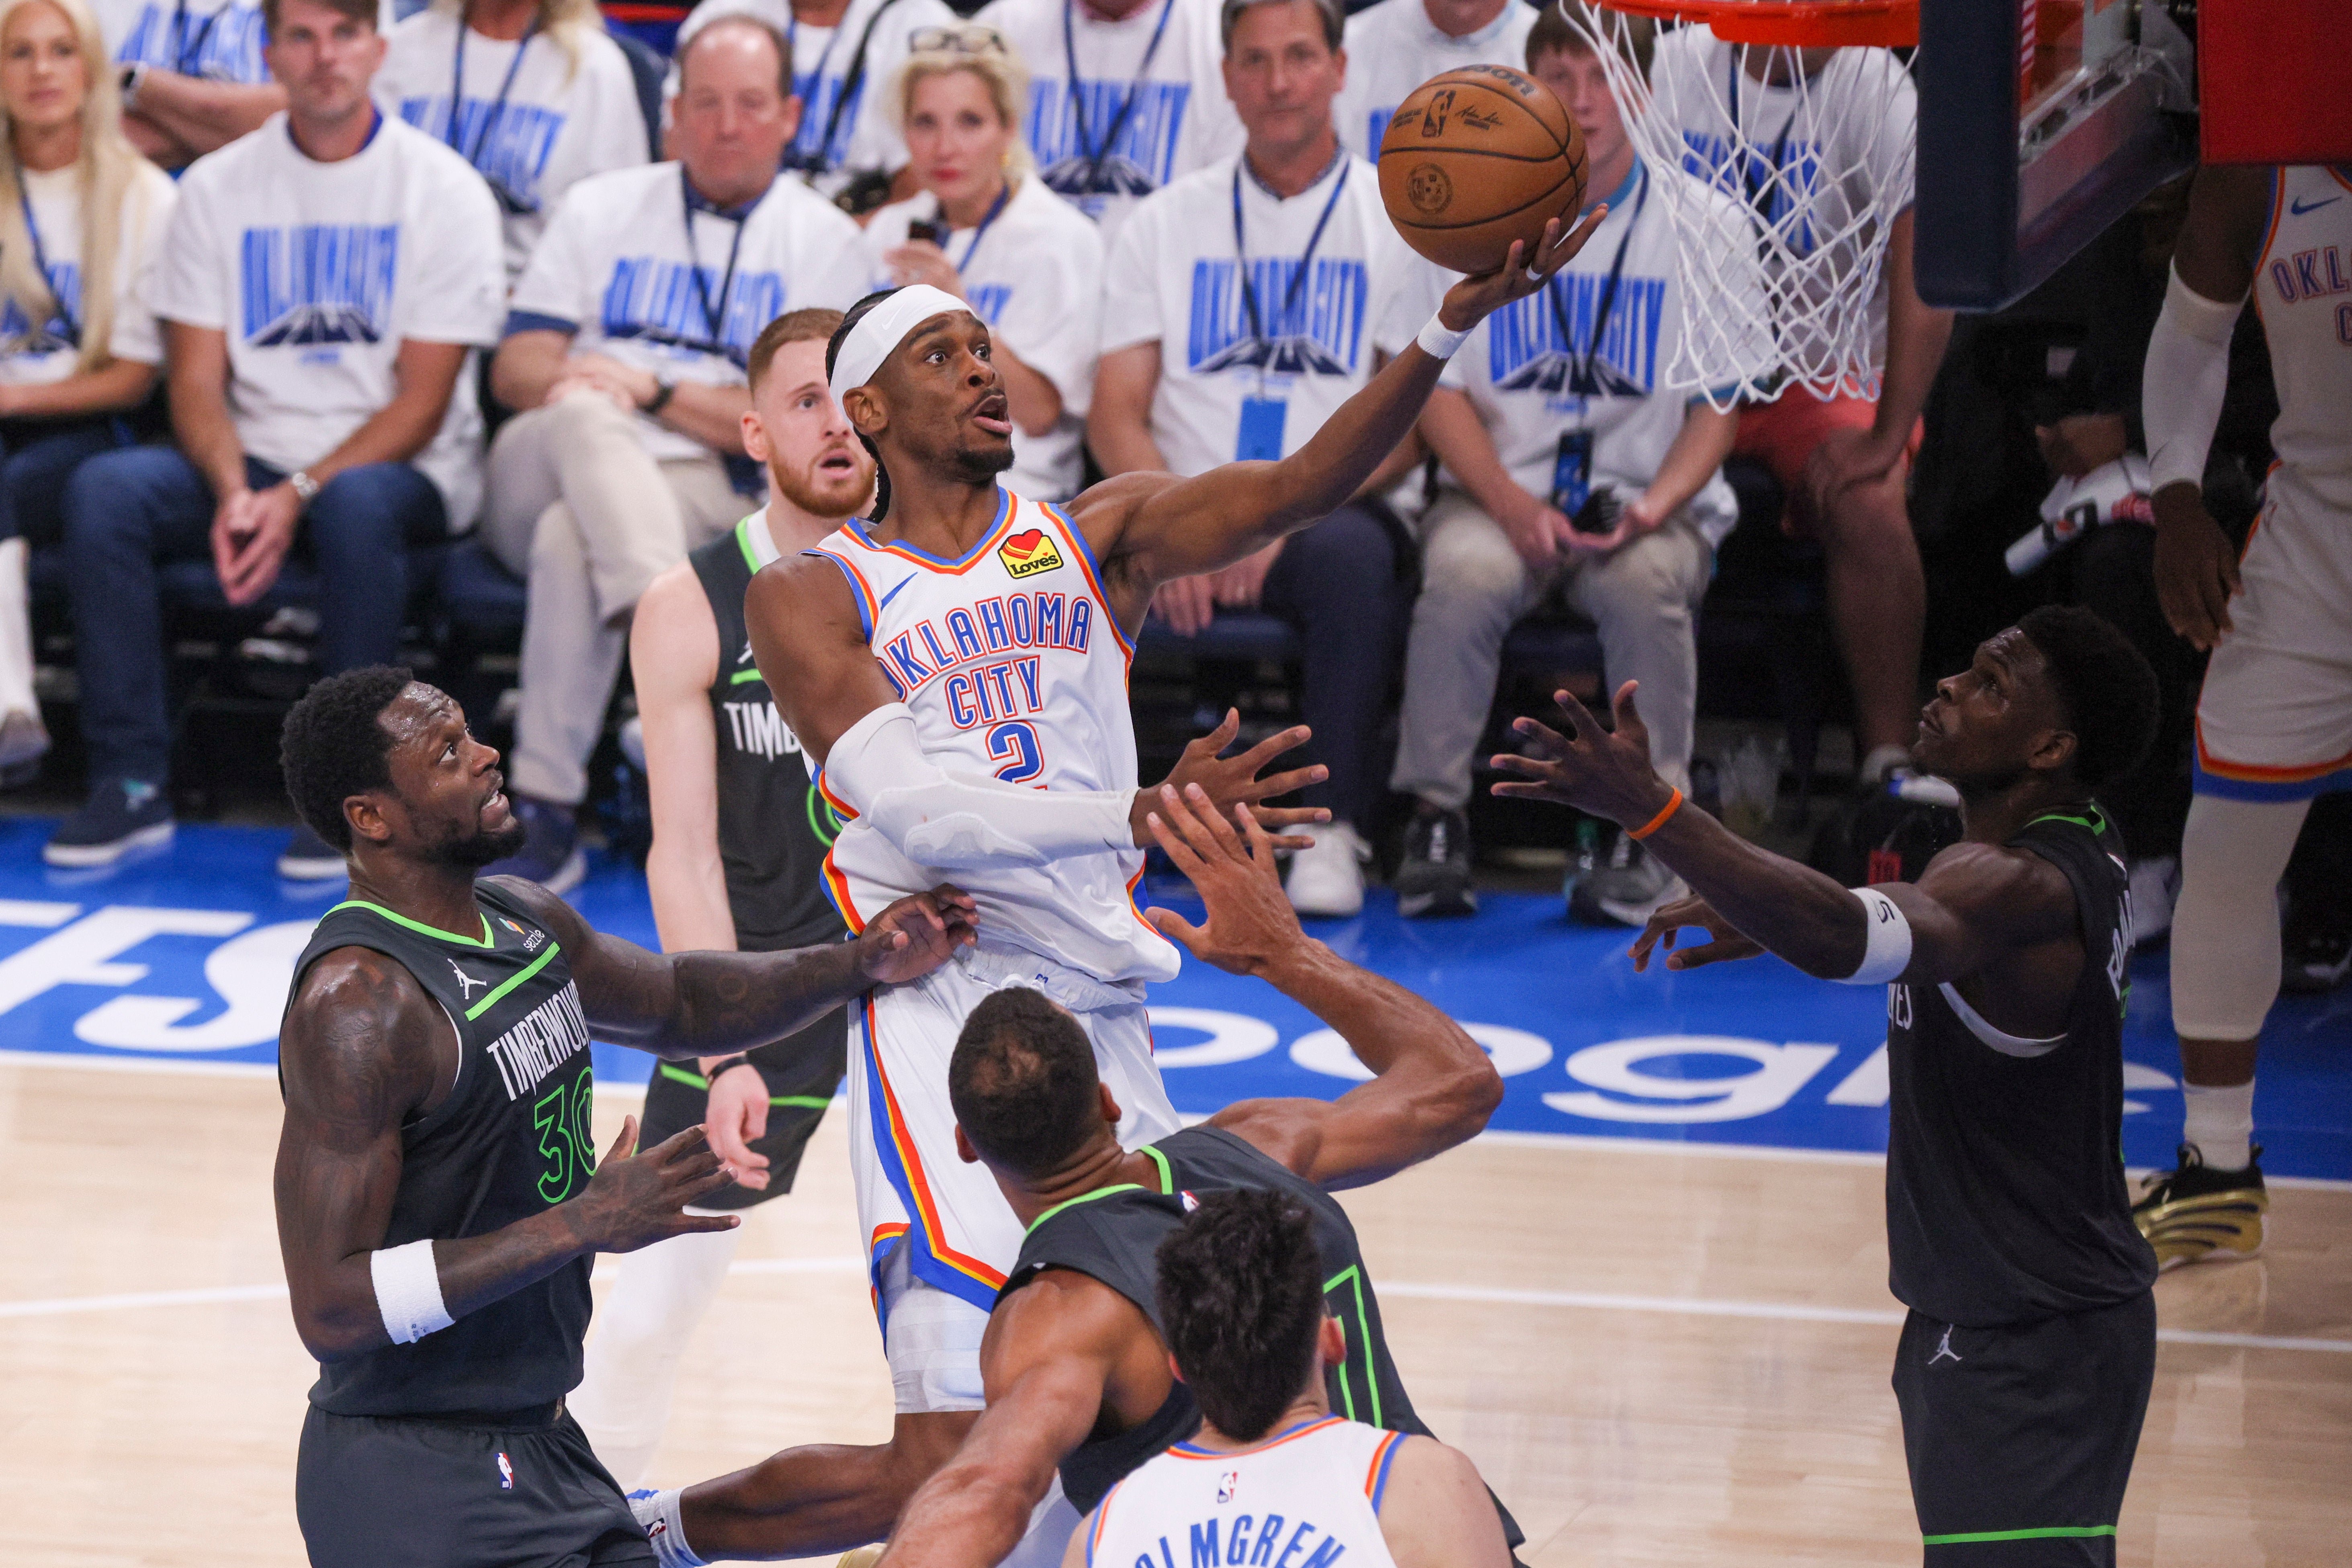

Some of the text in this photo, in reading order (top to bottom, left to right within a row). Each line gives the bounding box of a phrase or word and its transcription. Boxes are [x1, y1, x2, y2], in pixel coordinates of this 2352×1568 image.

[2270, 246, 2352, 304] OKL
[945, 655, 1043, 729] CITY
[985, 719, 1048, 790] 2
[523, 929, 545, 952] sezzle
[486, 978, 591, 1101] TIMBERWOLV
[534, 1066, 597, 1203] 30
